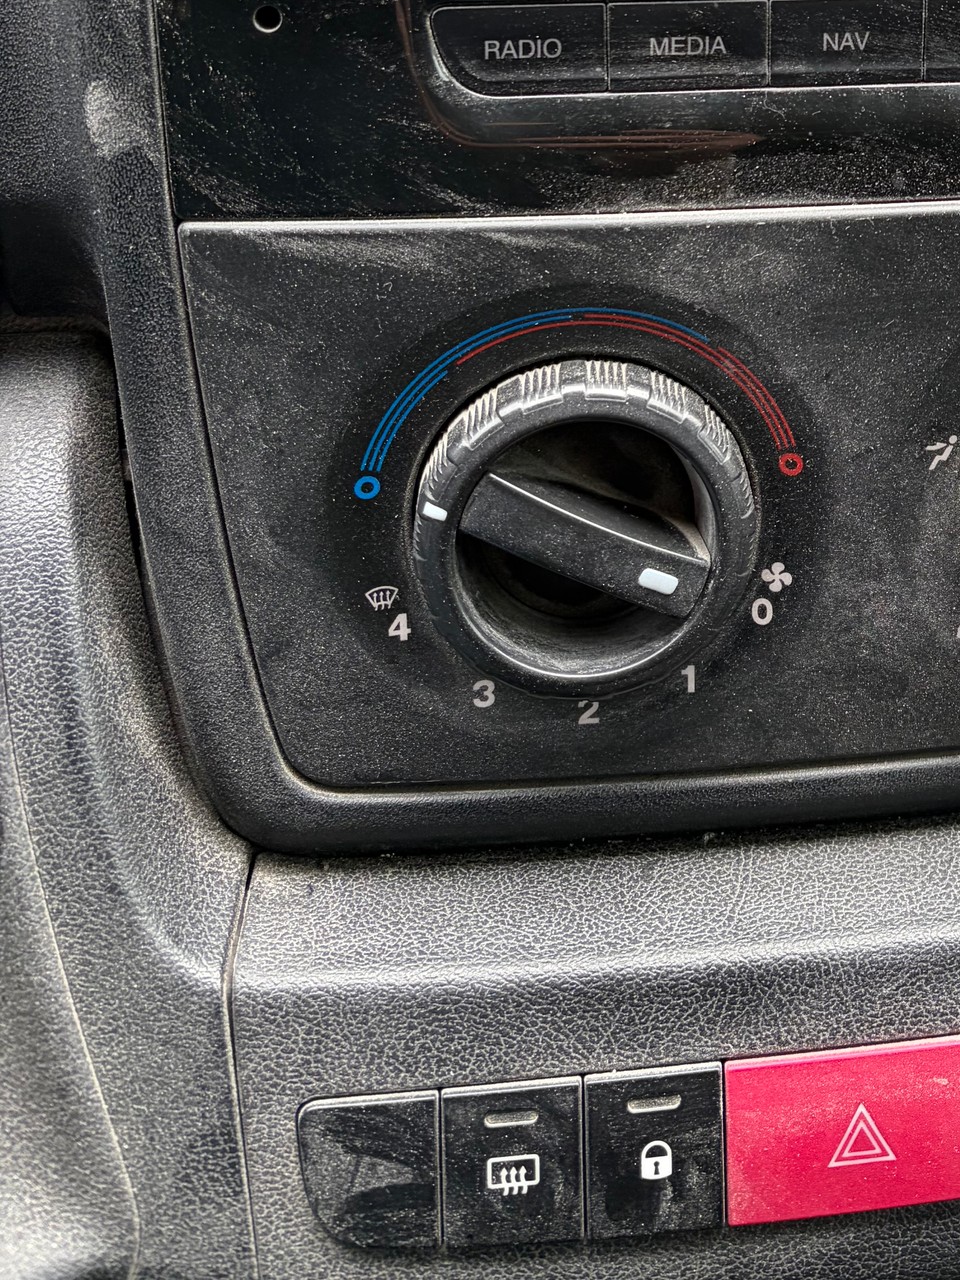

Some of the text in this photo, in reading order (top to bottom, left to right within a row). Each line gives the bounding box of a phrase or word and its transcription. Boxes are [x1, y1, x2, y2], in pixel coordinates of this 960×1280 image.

[484, 37, 563, 61] RADIO
[649, 35, 727, 56] MEDIA
[822, 31, 870, 52] NAV
[388, 613, 412, 641] 4
[681, 665, 696, 693] 1
[472, 679, 495, 708] 3
[578, 699, 601, 725] 2
